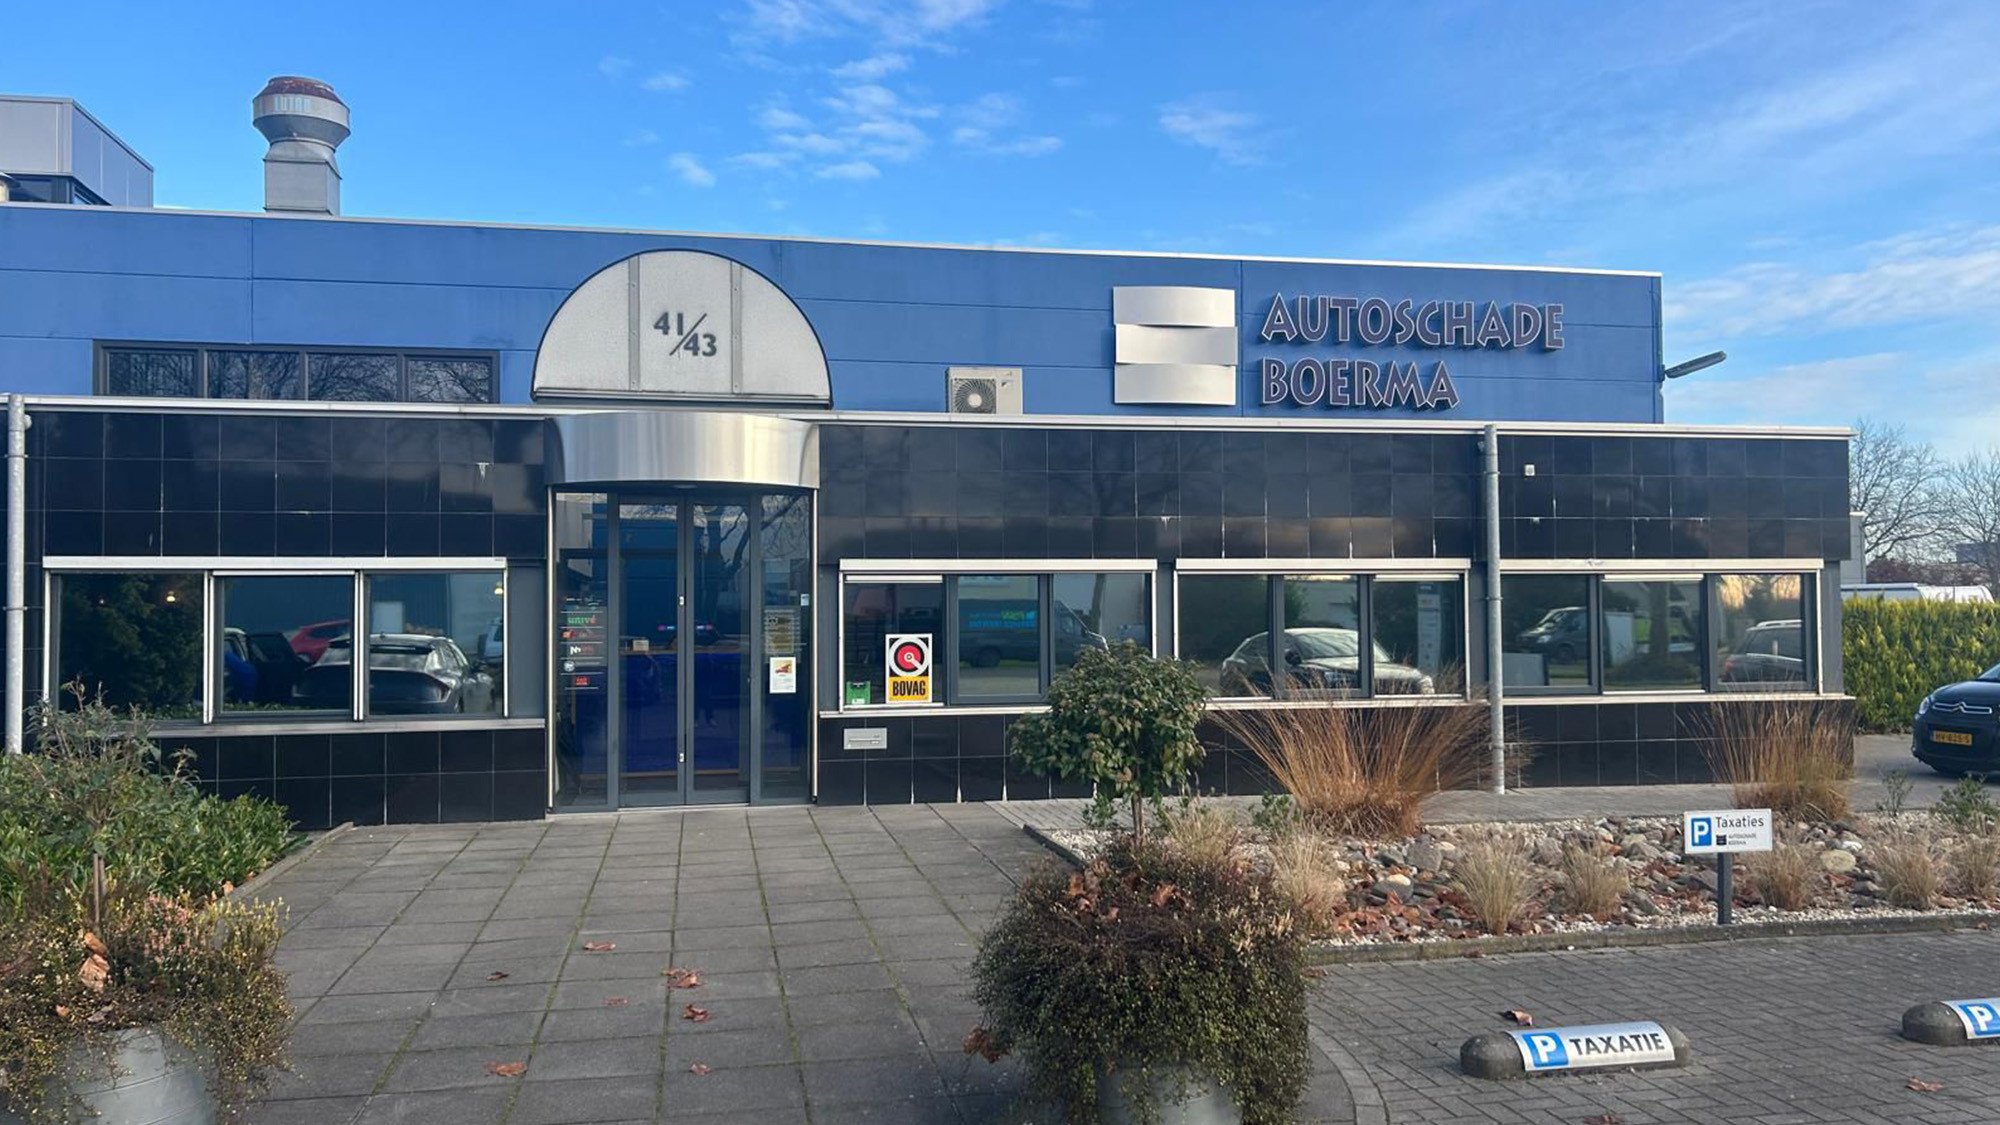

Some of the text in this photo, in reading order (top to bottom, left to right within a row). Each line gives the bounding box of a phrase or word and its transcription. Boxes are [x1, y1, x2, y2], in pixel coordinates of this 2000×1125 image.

[1261, 293, 1565, 349] AUTOSCHADE
[1261, 358, 1460, 409] BOERMA
[893, 680, 926, 696] BOVAG
[1716, 815, 1764, 828] Taxaties
[1569, 1033, 1665, 1056] TAXATIE
